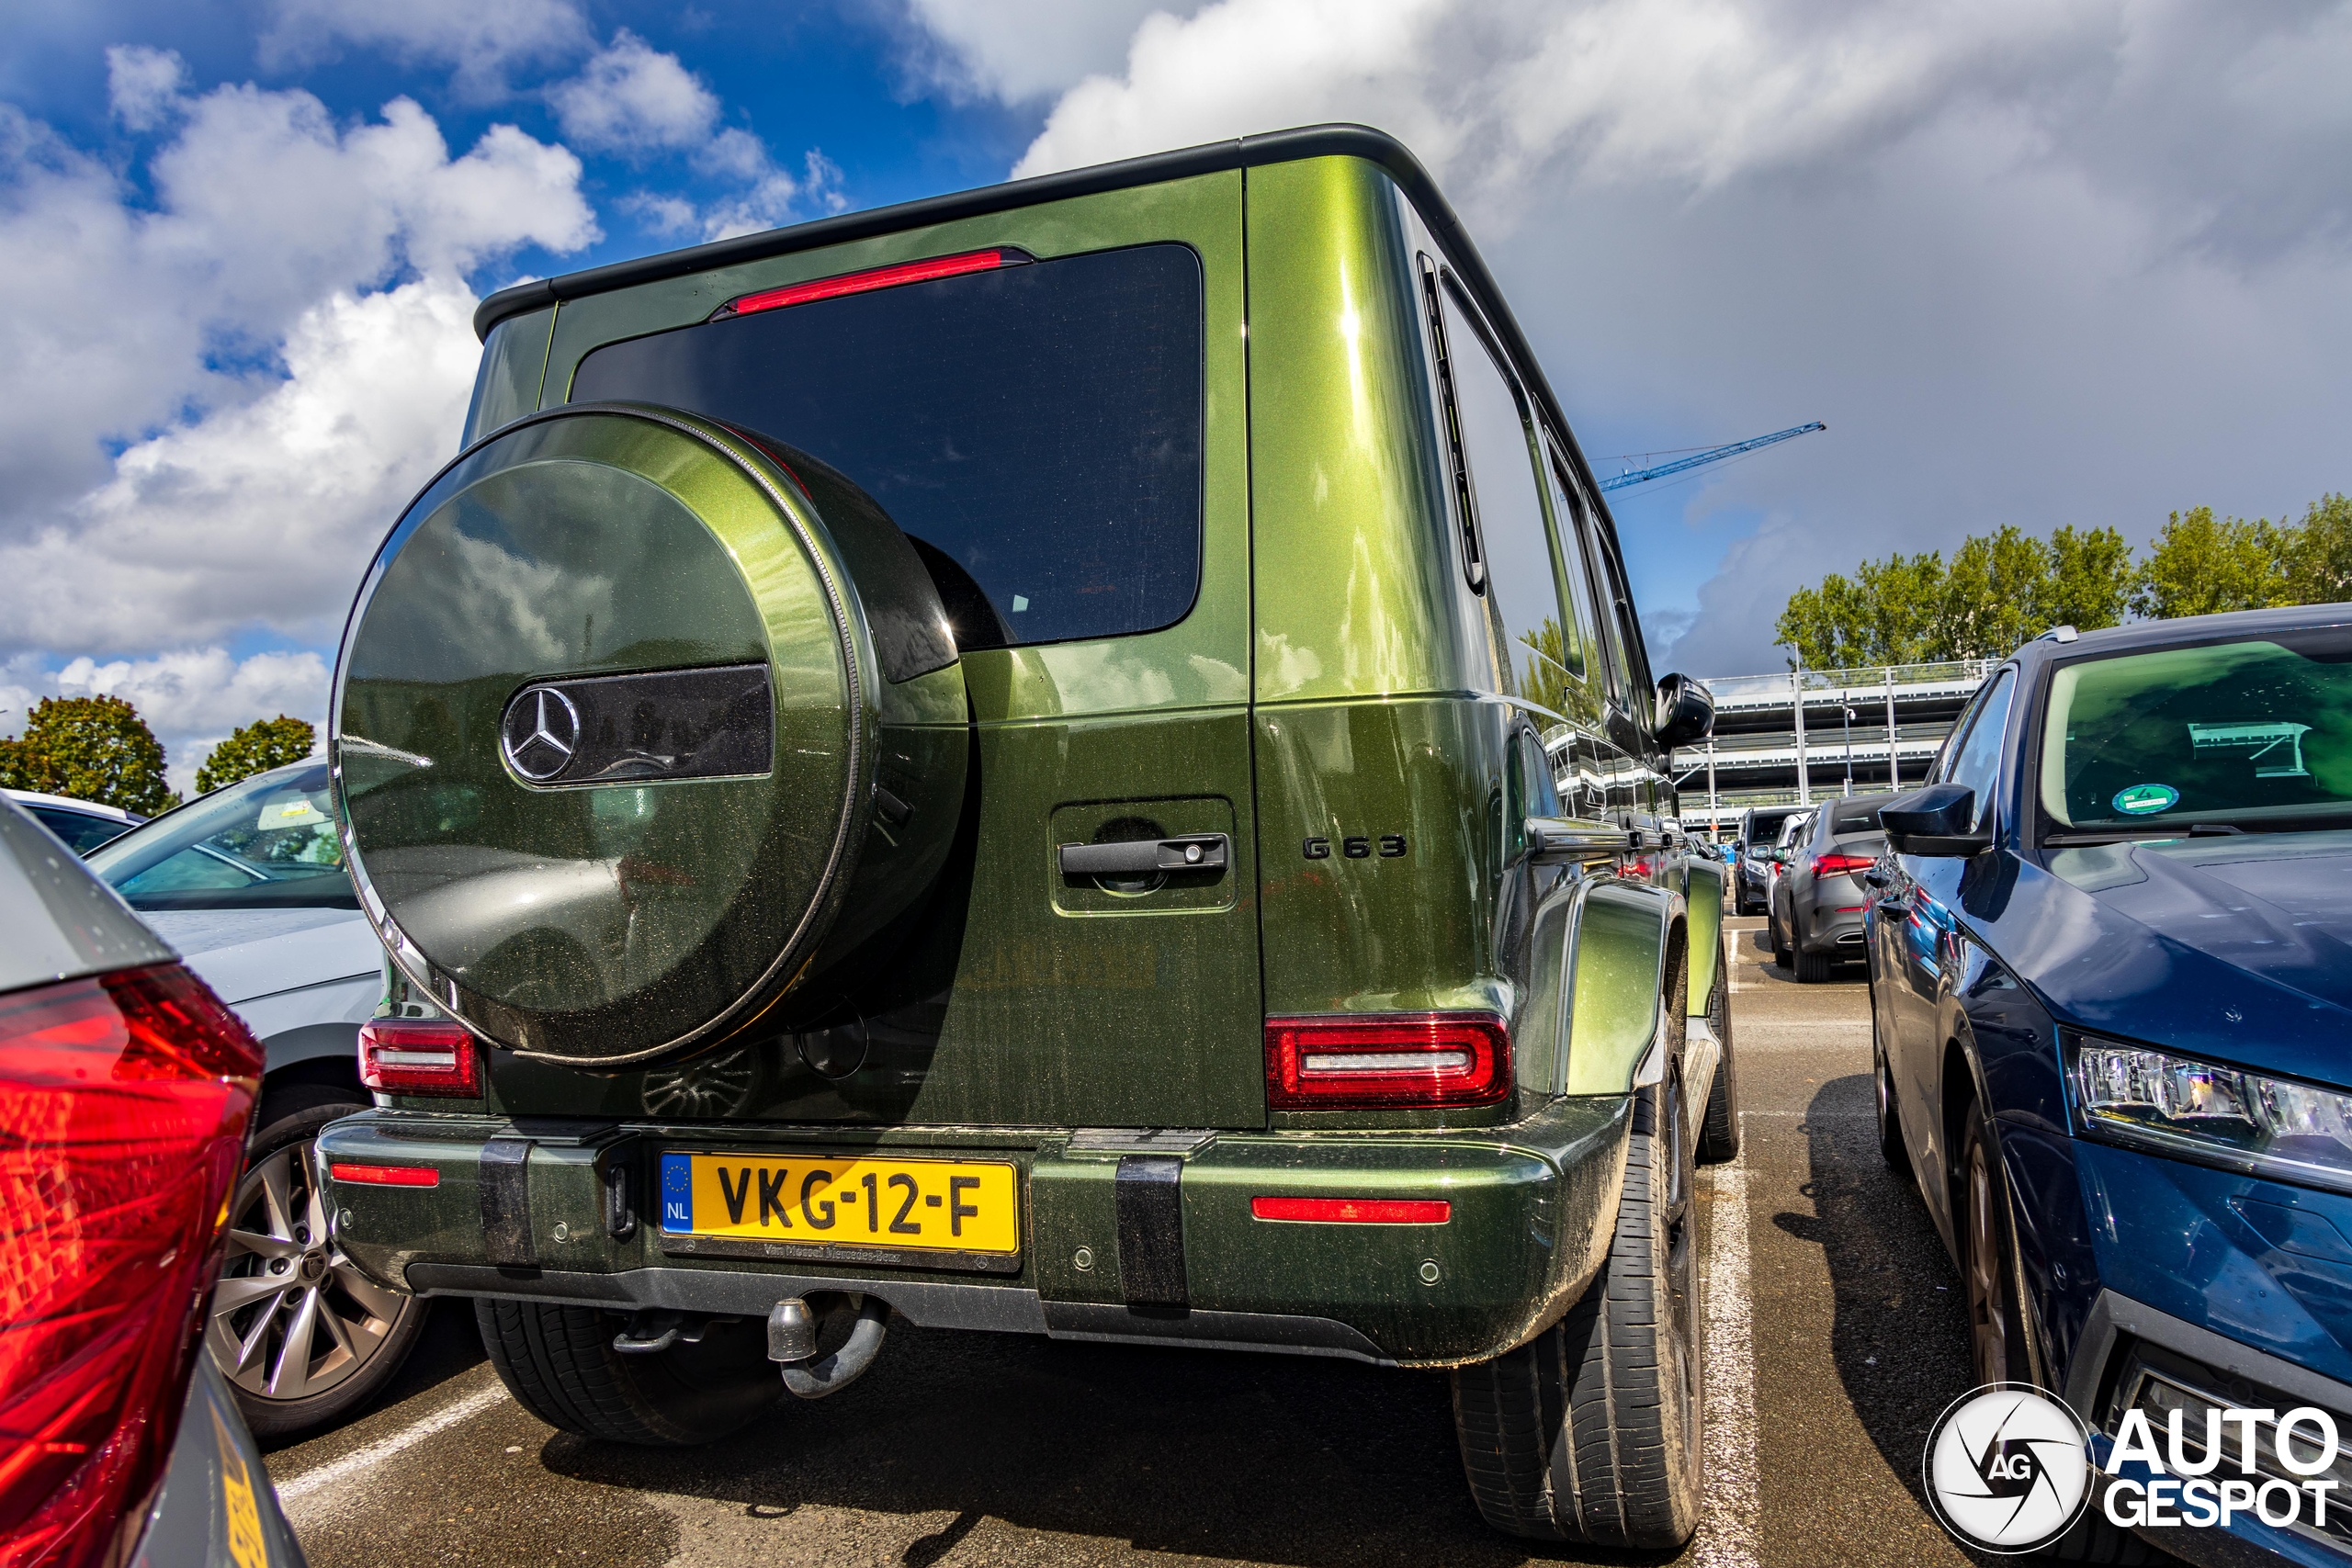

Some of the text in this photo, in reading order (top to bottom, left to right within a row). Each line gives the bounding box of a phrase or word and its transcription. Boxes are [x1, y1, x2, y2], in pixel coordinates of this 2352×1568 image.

[2137, 788, 2153, 798] 4
[1303, 834, 1408, 860] G 63
[667, 1201, 689, 1220] NL
[717, 1167, 980, 1237] VKG-12-F
[764, 1244, 786, 1256] Van
[825, 1247, 900, 1262] Mercedes-Benz
